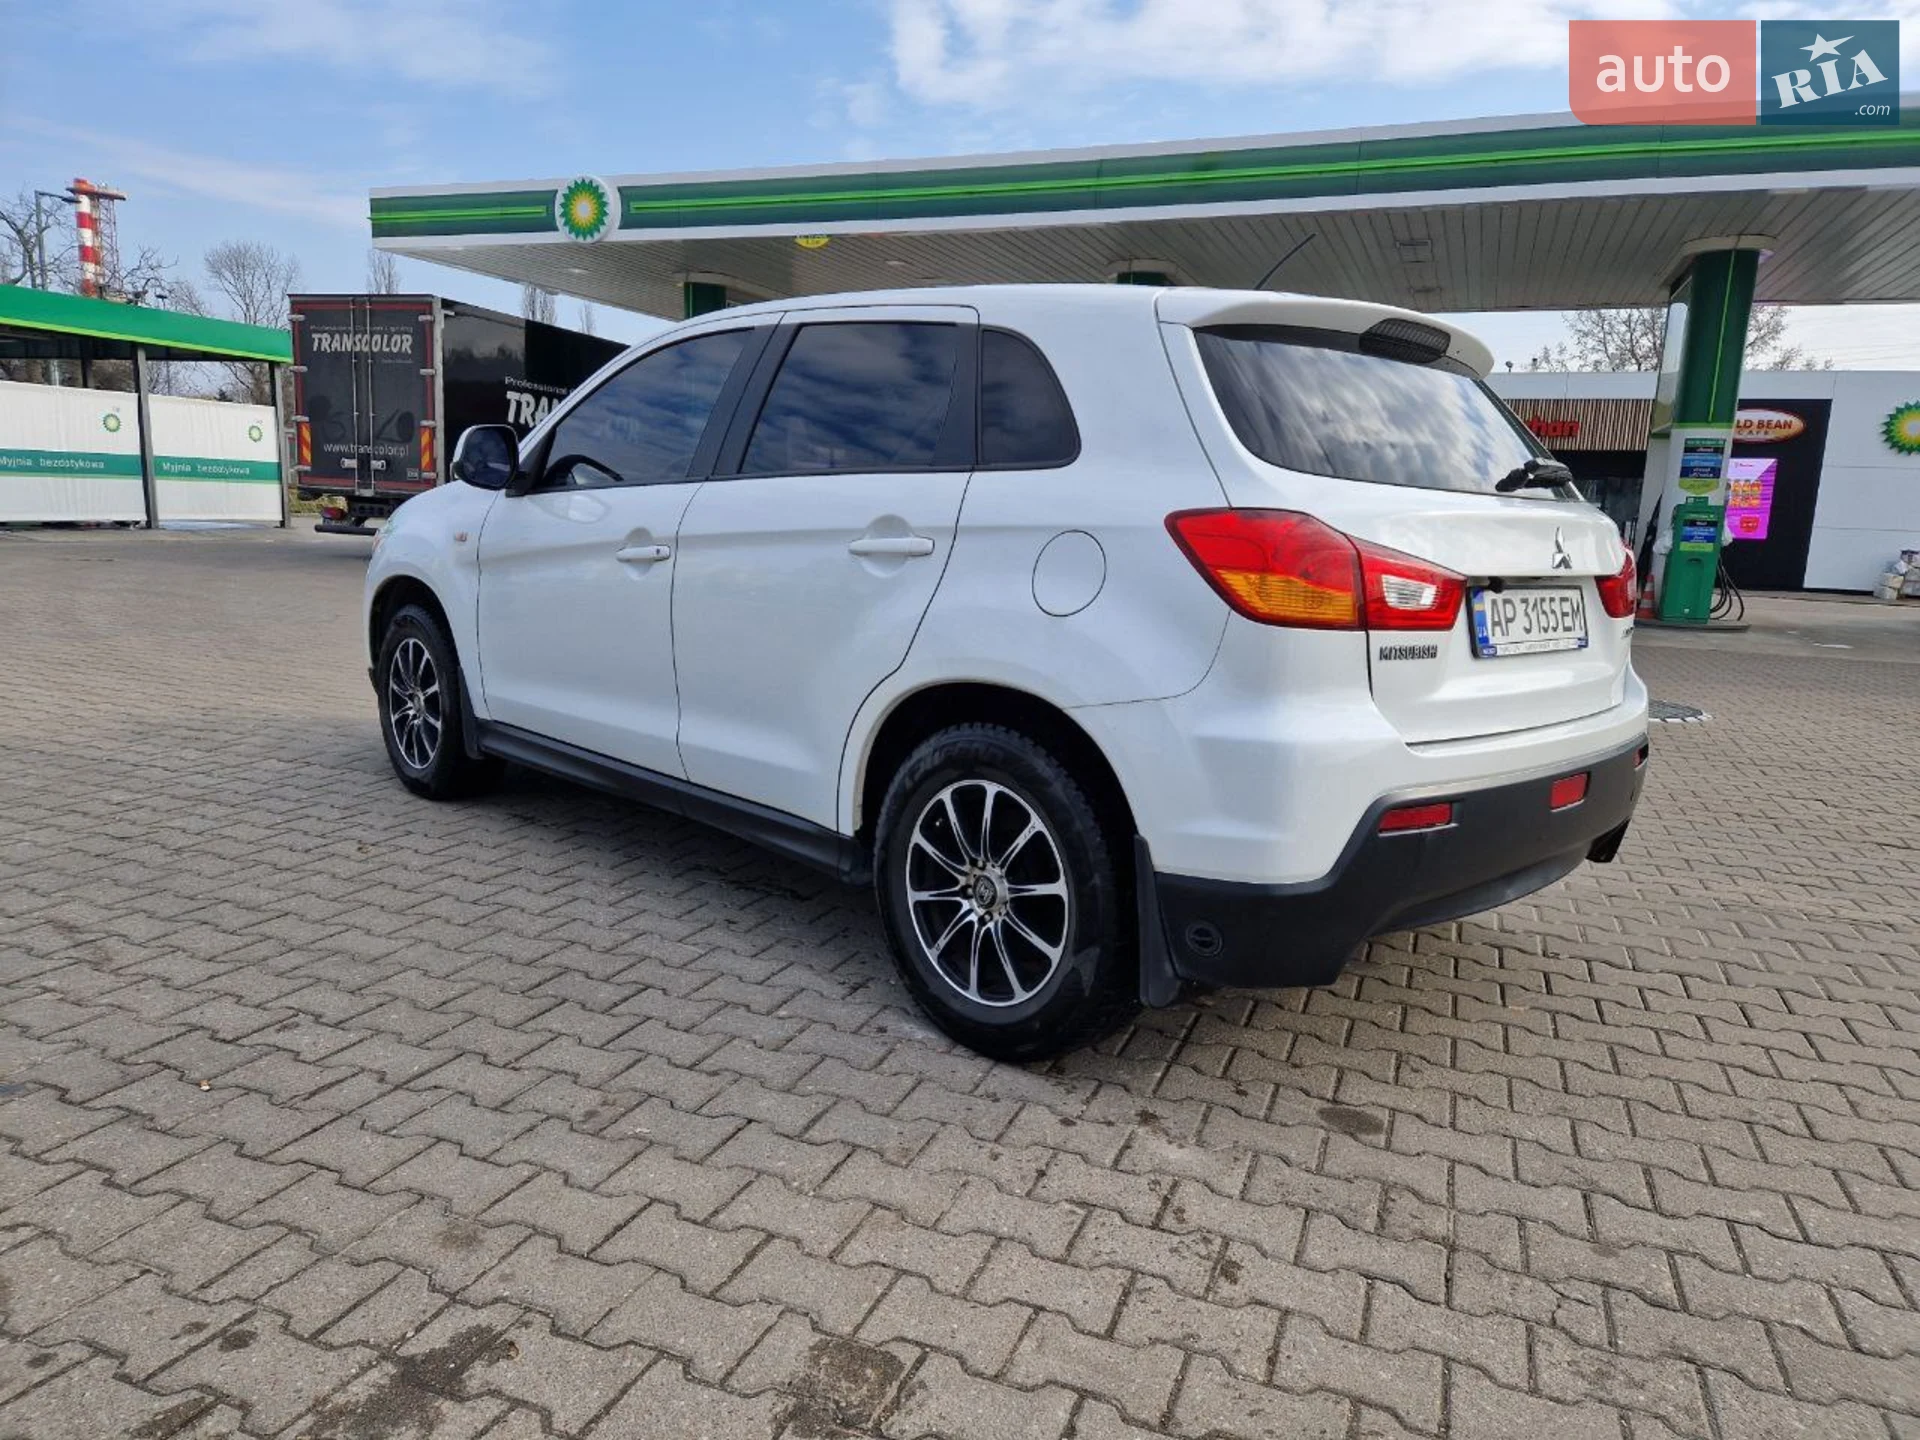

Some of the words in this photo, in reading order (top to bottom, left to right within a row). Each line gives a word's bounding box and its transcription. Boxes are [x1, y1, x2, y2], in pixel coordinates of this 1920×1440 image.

[312, 333, 413, 354] TRANSCOLOR
[1736, 419, 1753, 429] LD
[1757, 419, 1793, 430] BEAN
[1491, 597, 1517, 637] AP
